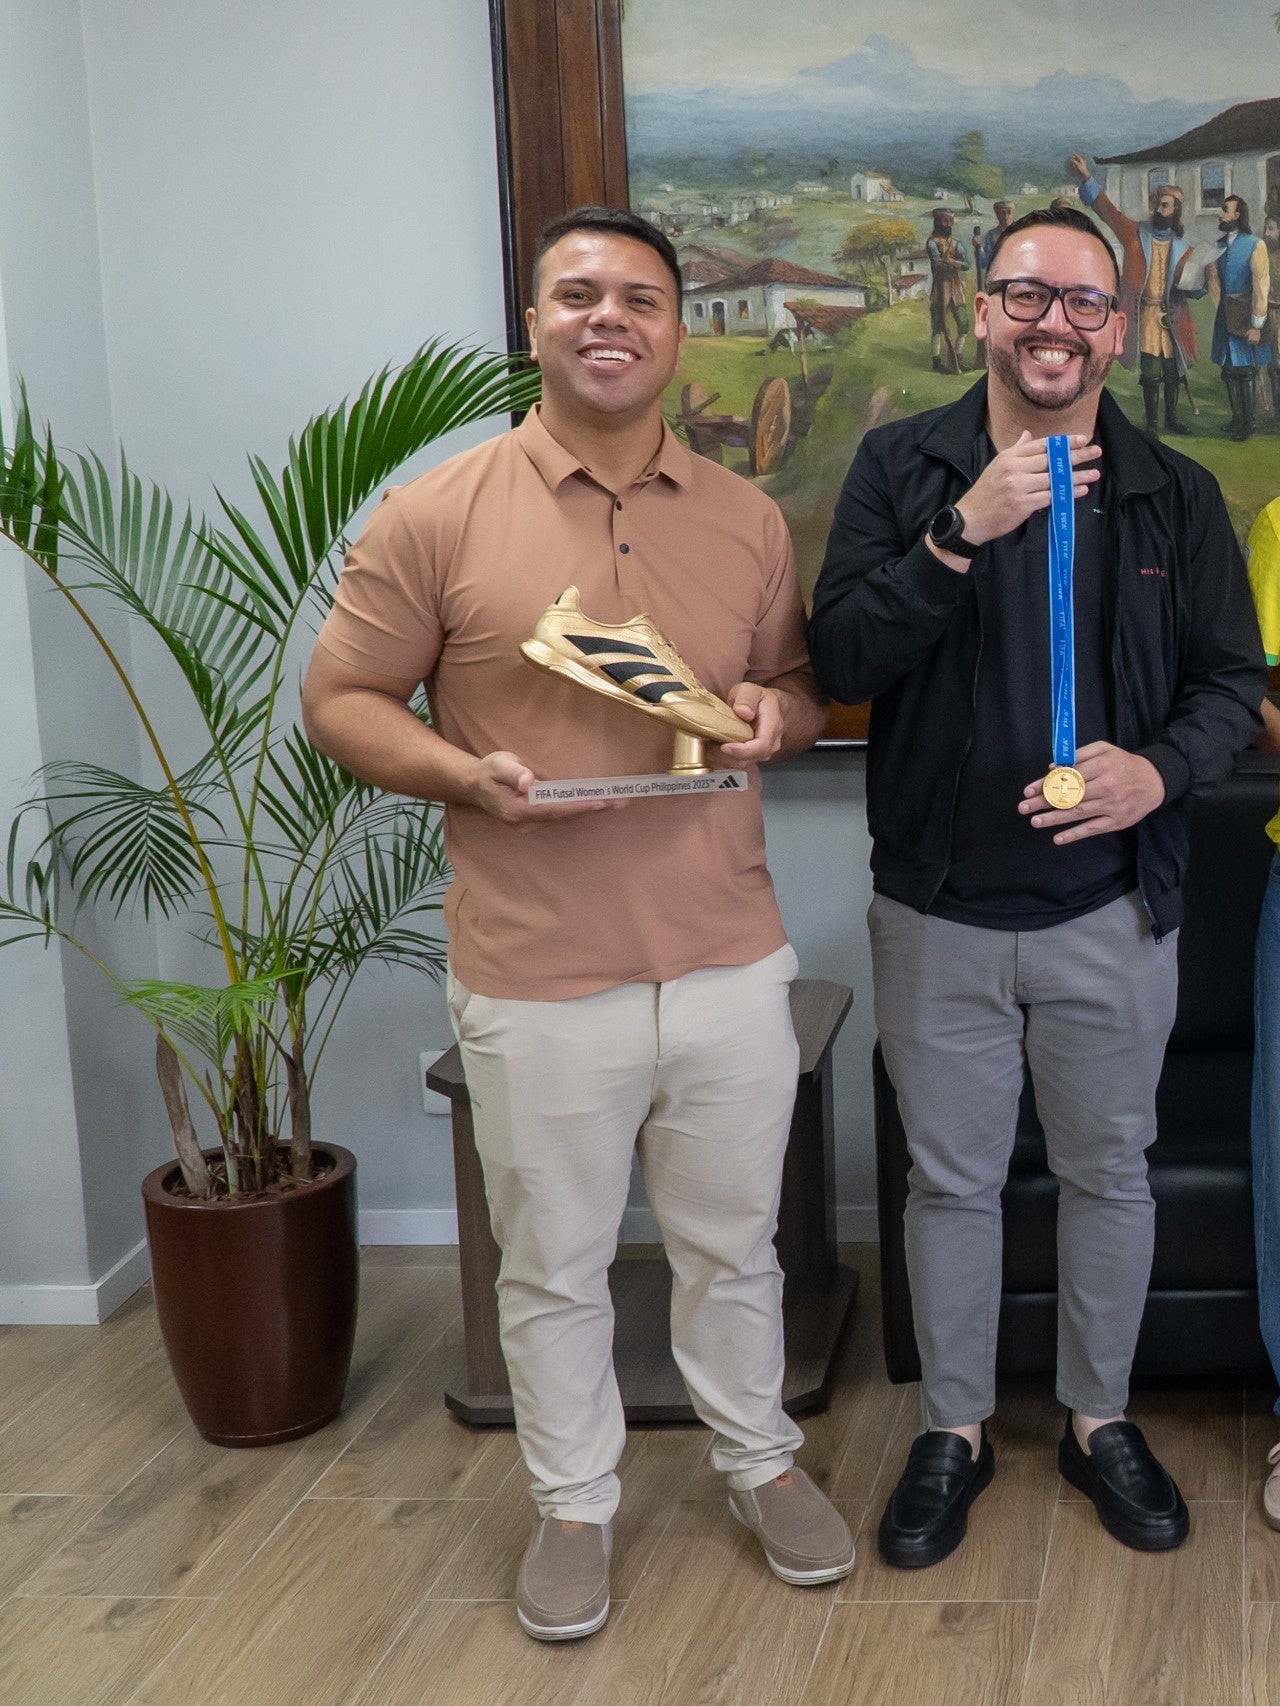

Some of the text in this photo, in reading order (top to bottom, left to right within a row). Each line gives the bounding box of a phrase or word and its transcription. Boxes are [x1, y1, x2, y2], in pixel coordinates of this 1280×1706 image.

[535, 789, 551, 800] FIFA
[553, 788, 575, 799] Futsal
[612, 784, 633, 794] World
[635, 783, 650, 794] Cup
[651, 782, 691, 793] Philippines
